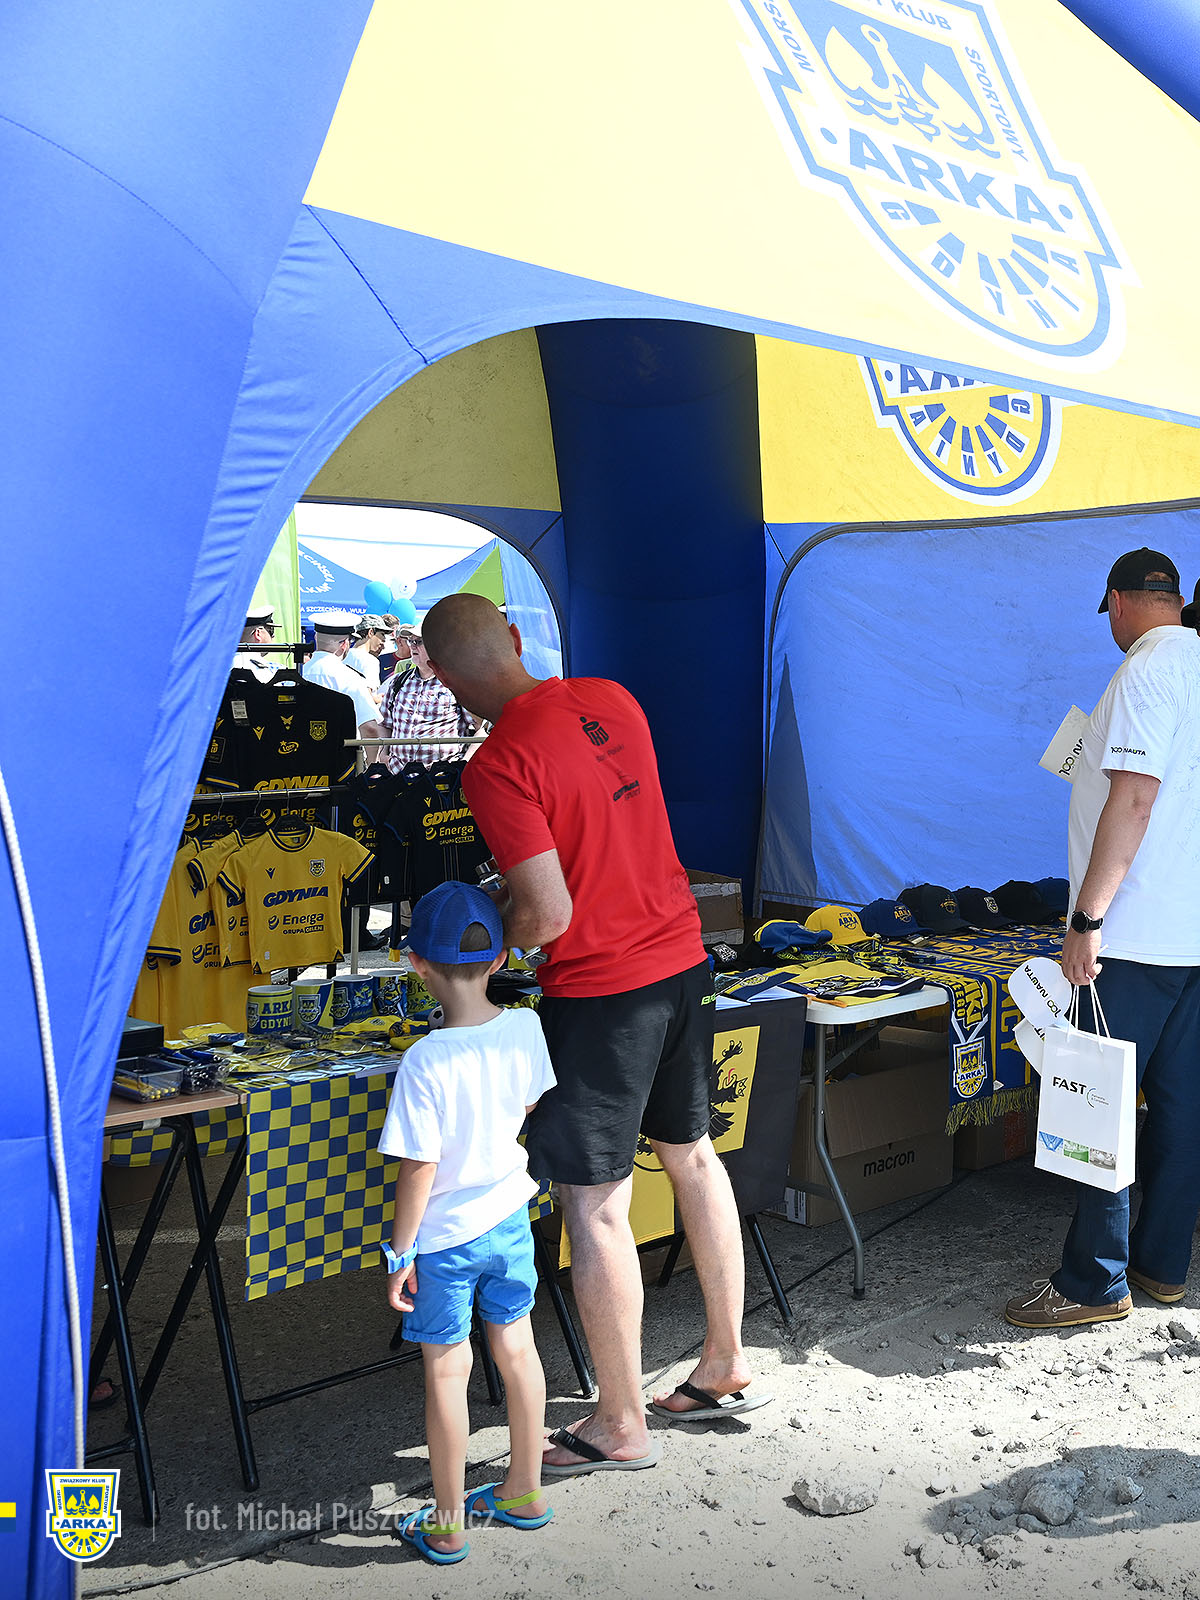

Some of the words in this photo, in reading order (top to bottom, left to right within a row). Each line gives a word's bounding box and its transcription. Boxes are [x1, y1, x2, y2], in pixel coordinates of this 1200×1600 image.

[965, 46, 1029, 162] SPORTOWY
[848, 128, 1066, 234] ARKA
[880, 200, 1081, 330] GDYNIA
[1123, 747, 1146, 756] NAUTA
[439, 825, 474, 837] Energa
[263, 887, 329, 909] GDYNIA
[283, 913, 325, 926] Energa
[960, 1069, 982, 1081] ARKA
[1052, 1076, 1087, 1095] FAST
[864, 1150, 915, 1177] macron
